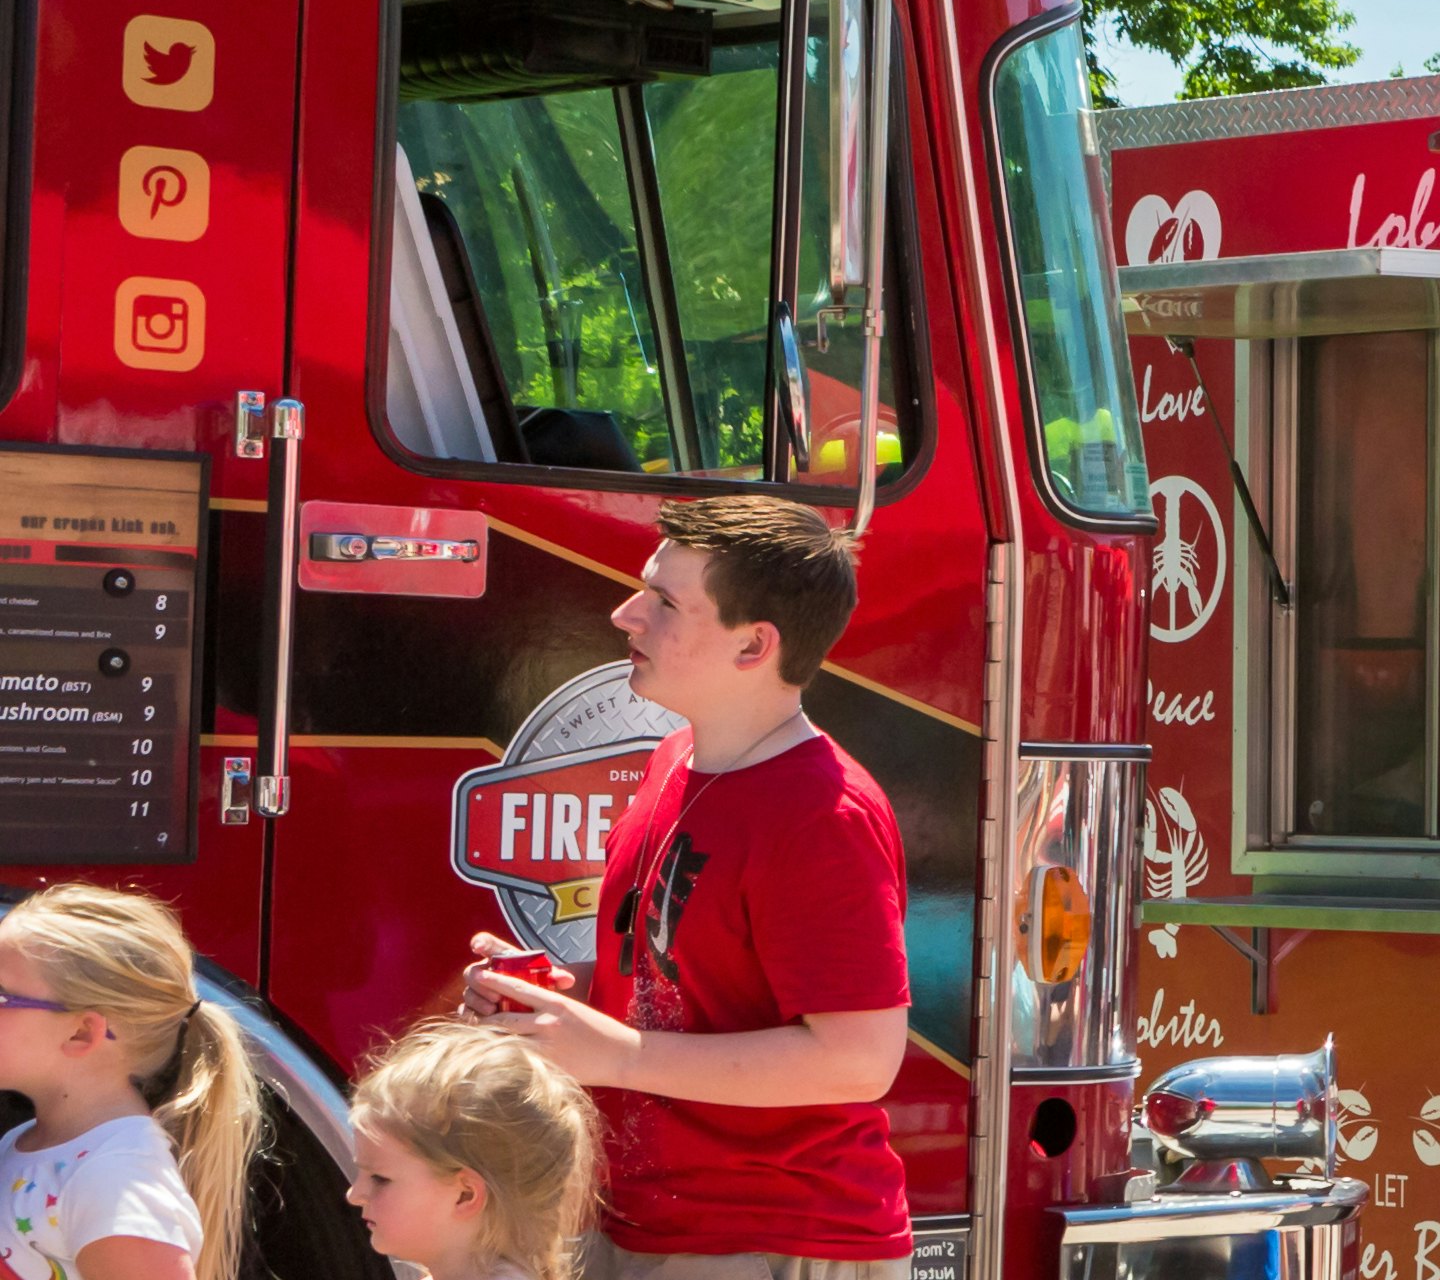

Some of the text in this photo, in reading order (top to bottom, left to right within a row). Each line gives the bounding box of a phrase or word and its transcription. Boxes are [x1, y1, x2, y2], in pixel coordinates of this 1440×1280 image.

[1142, 365, 1205, 422] Love
[155, 595, 167, 610] 8
[155, 624, 166, 640] 9
[0, 674, 153, 693] mato (BST) 9
[0, 702, 155, 723] ushroom (BSM) 9
[1148, 686, 1215, 725] eace
[560, 697, 617, 739] SWEET
[131, 739, 153, 755] 10
[131, 770, 152, 786] 10
[130, 802, 149, 817] 11
[500, 792, 613, 861] FIRE
[1137, 988, 1224, 1048] obster
[1375, 1174, 1408, 1208] LET
